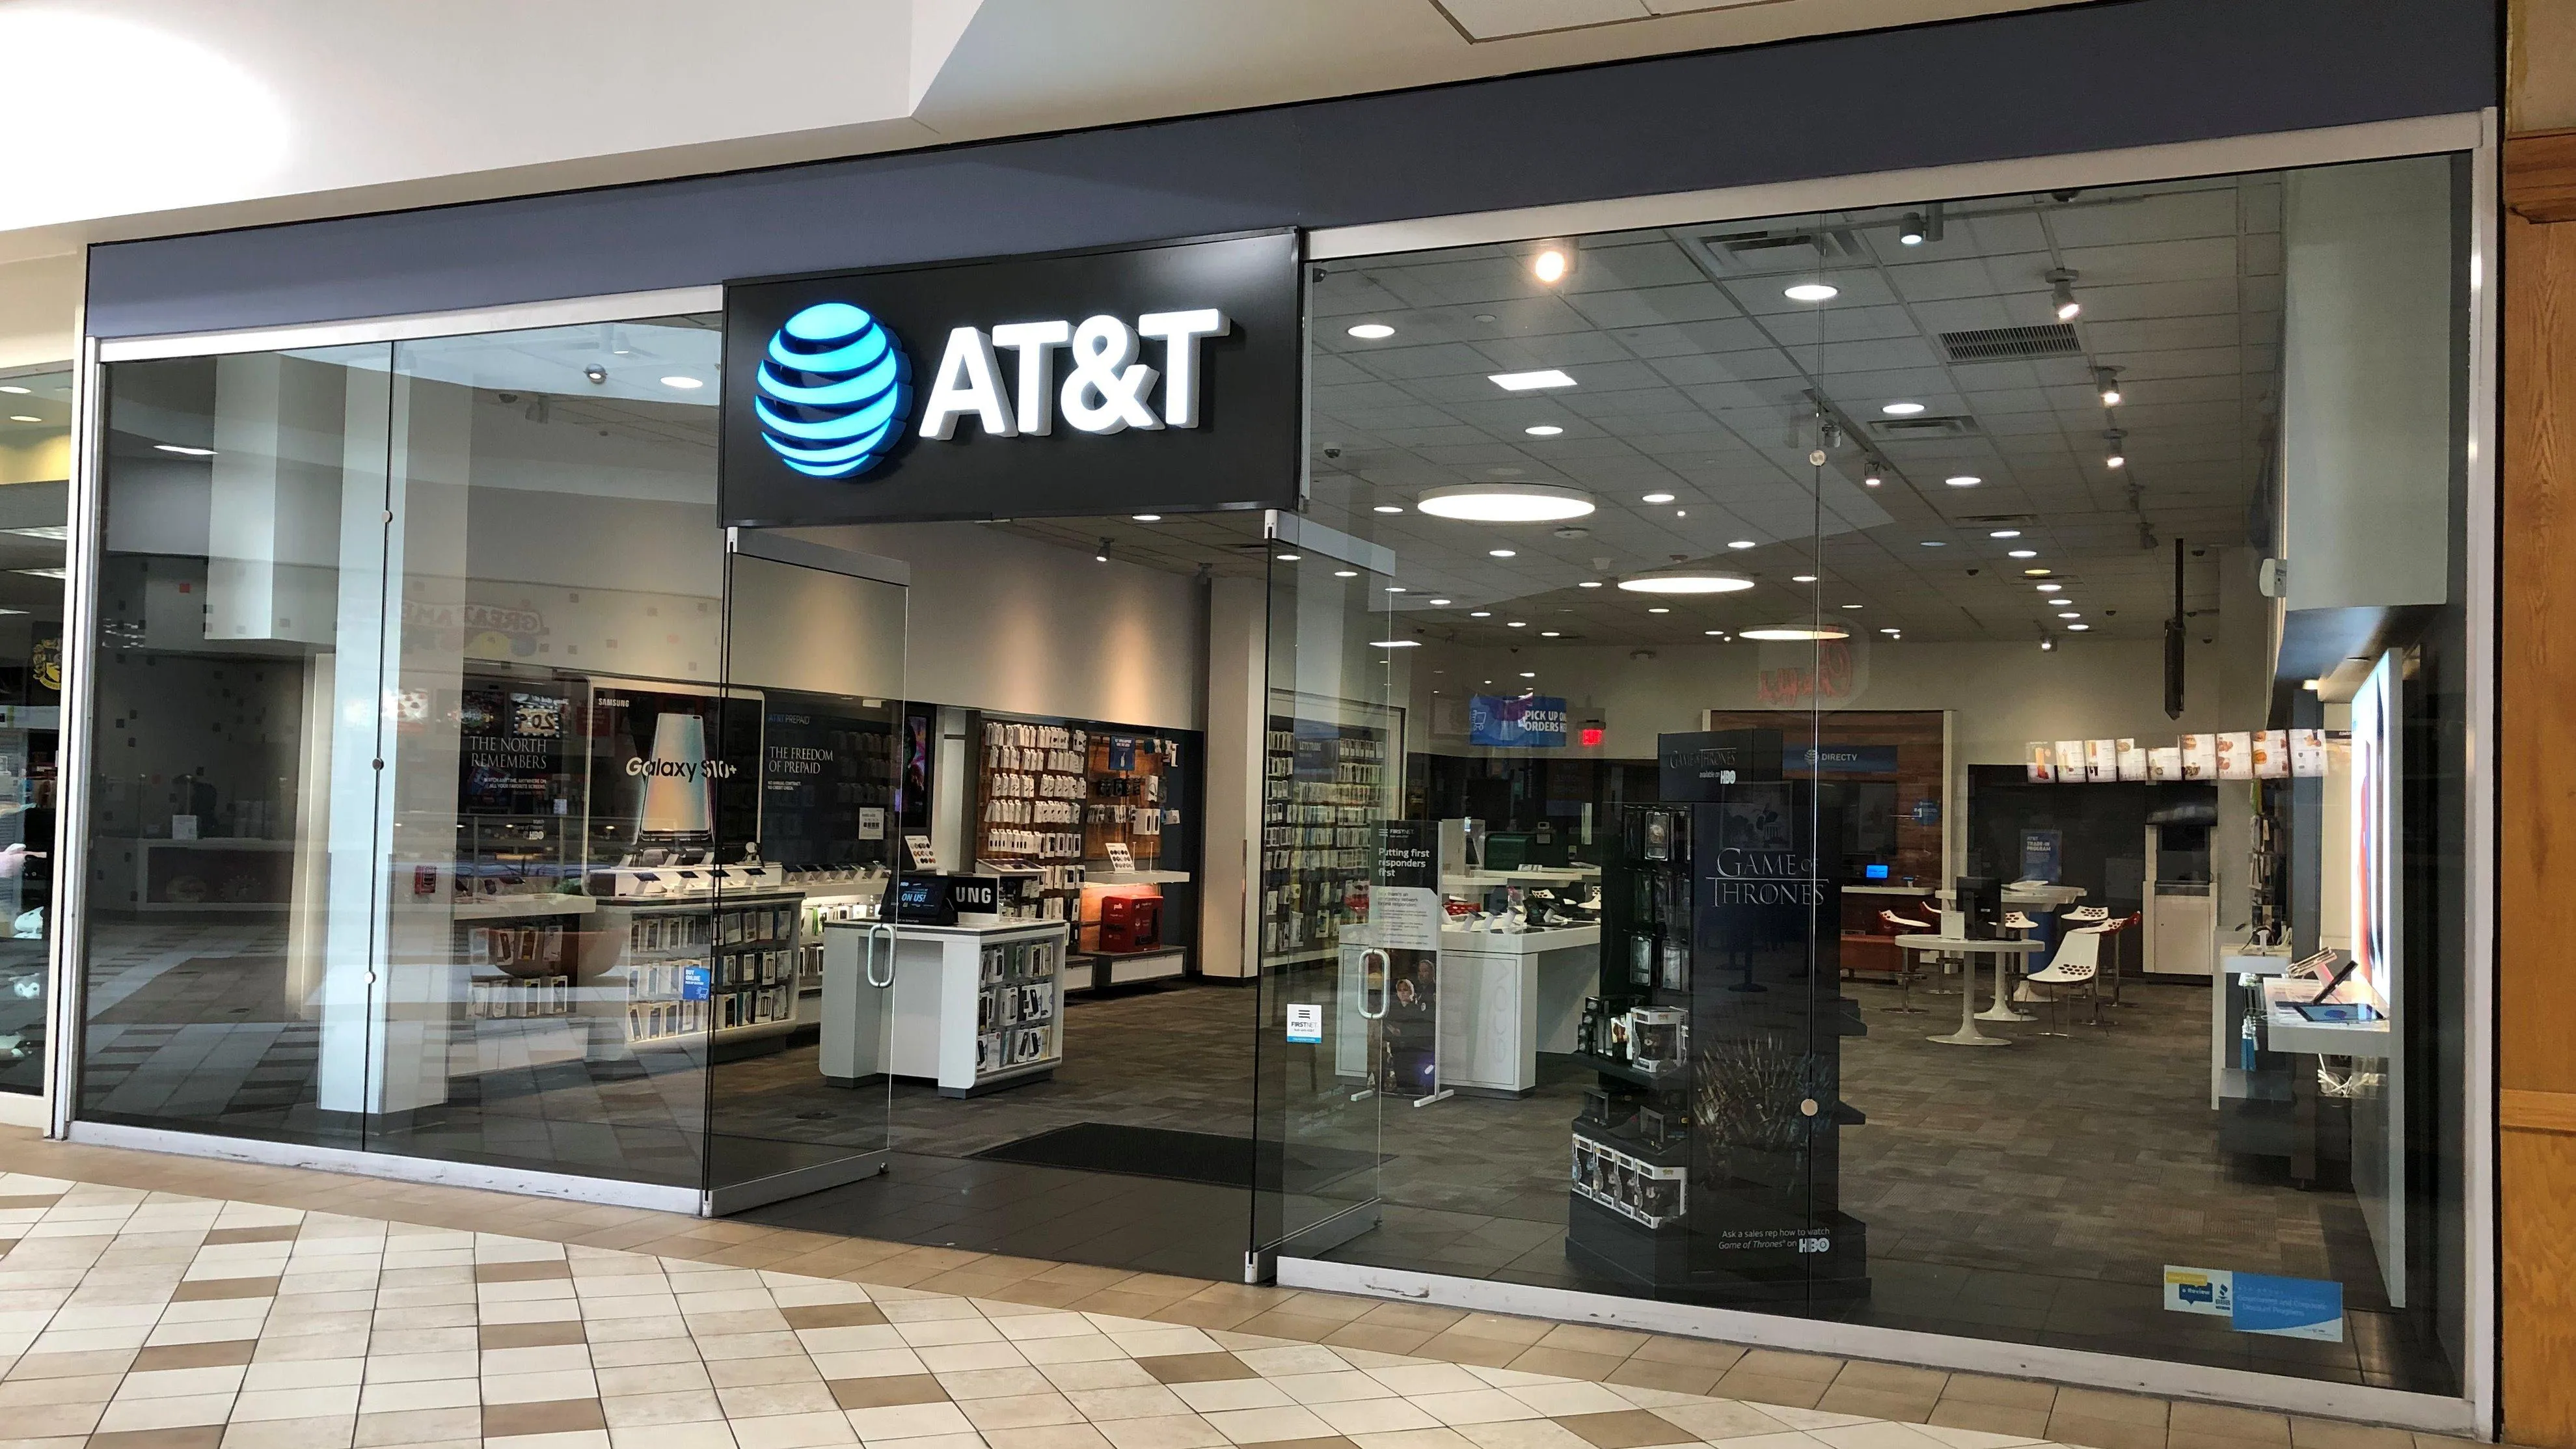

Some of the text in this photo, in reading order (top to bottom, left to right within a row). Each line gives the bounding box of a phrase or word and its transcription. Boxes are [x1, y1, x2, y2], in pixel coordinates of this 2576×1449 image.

[919, 309, 1230, 440] AT&T
[598, 697, 629, 707] SAMSUNG
[1525, 710, 1546, 720] PICK
[1549, 711, 1558, 721] UP
[1525, 722, 1558, 732] ORDERS
[470, 736, 547, 753] THE NORTH
[769, 746, 834, 761] THE FREEDOM
[471, 753, 547, 769] REMEMBERS
[769, 760, 820, 774] OF PREPAID
[626, 757, 737, 782] Galaxy S10+
[1720, 770, 1736, 784] HBO
[1411, 848, 1430, 858] first
[1716, 847, 1796, 877] GAME
[901, 893, 926, 902] ON US!
[1705, 876, 1829, 908] THRONES
[1744, 1229, 1764, 1238] sales
[1765, 1230, 1778, 1238] rep
[1780, 1228, 1796, 1236] how
[1808, 1227, 1830, 1236] watch
[1742, 1240, 1752, 1250] of
[1798, 1238, 1830, 1253] HBO
